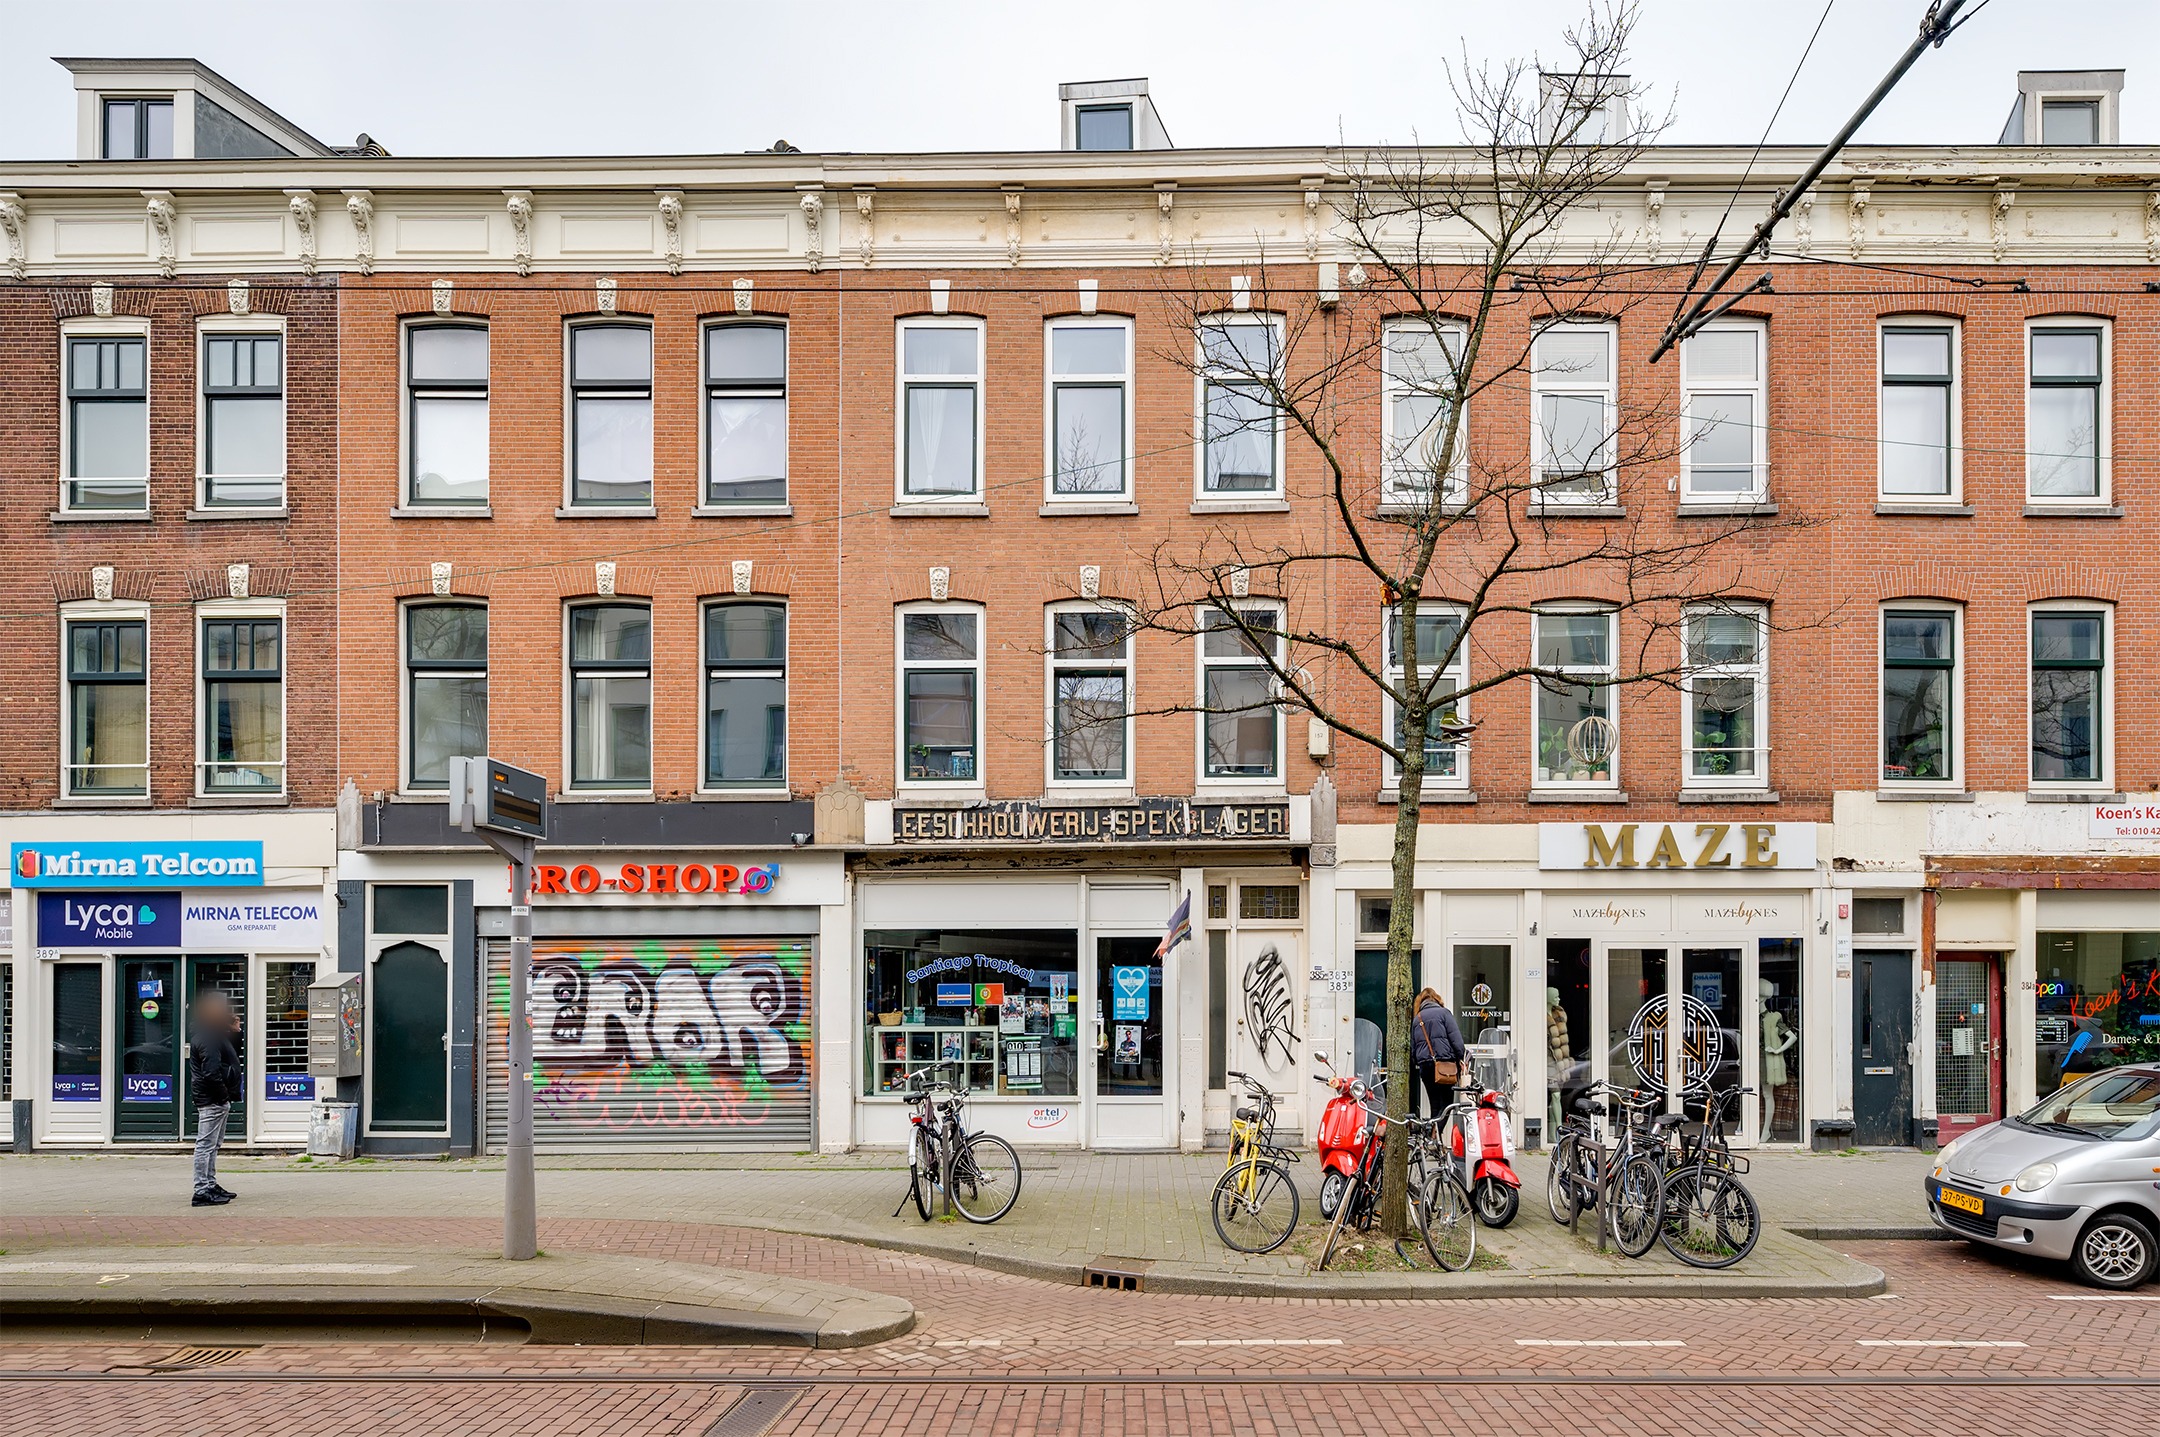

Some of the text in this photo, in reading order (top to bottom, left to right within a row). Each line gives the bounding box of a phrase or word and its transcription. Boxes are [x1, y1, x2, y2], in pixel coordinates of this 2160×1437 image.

[2096, 806, 2142, 820] Koen's
[2115, 827, 2131, 836] Tel:
[2132, 827, 2149, 836] 010
[1583, 824, 1779, 867] MAZE
[44, 851, 258, 877] Mirna Telcom
[64, 899, 134, 931] Lyca
[186, 906, 318, 921] MIRNA TELECOM
[95, 927, 133, 939] Mobile
[906, 953, 1036, 984] Santiago Tropical
[2102, 1033, 2140, 1045] Dames-
[2143, 1033, 2154, 1044] &
[55, 1082, 71, 1090] Lyca
[128, 1078, 158, 1092] Lyca
[274, 1081, 299, 1094] Lyca
[1034, 1108, 1060, 1117] ortel
[1943, 1190, 1980, 1211] 37-PS-VD
